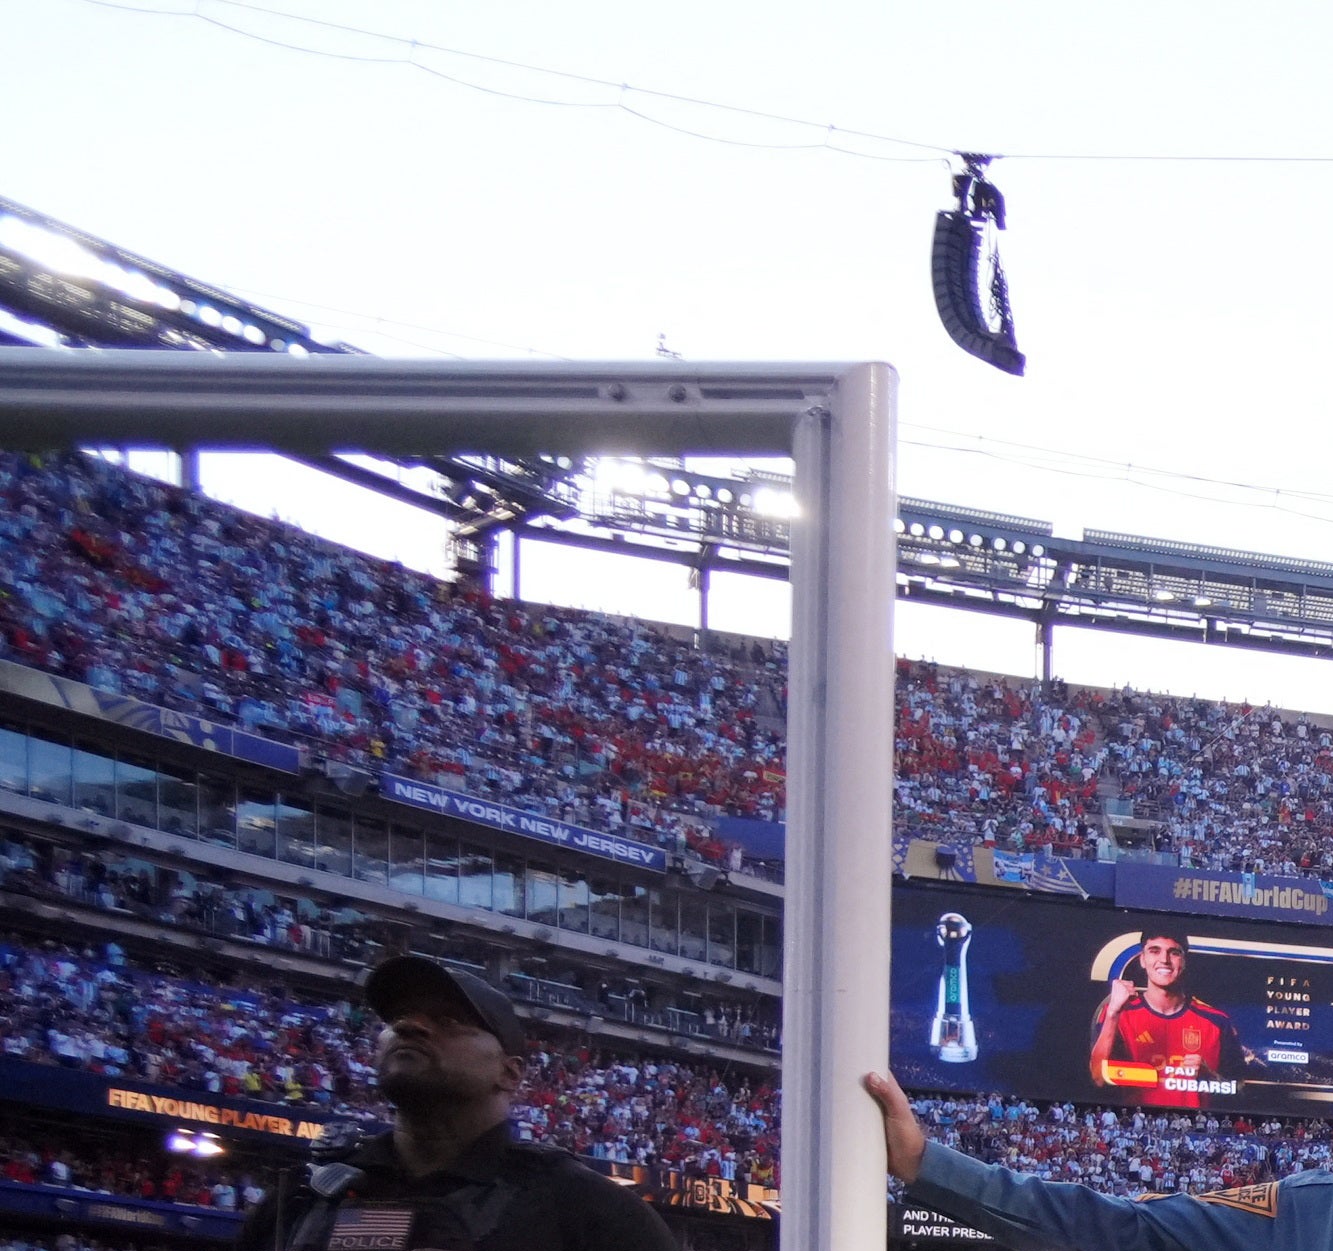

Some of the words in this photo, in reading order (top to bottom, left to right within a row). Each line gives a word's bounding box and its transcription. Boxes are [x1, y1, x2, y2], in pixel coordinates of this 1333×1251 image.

[394, 782, 449, 808] NEW
[453, 798, 516, 828] YORK
[520, 816, 570, 841] NEW
[574, 833, 655, 864] JERSEY
[1267, 976, 1310, 987] FIFA
[1266, 990, 1310, 1002] YOUNG
[1266, 1005, 1310, 1017] PLAYER
[1266, 1020, 1310, 1031] AWARD
[1270, 1052, 1306, 1062] aramco
[108, 1088, 150, 1111] FIFA
[150, 1094, 221, 1124] YOUNG
[221, 1108, 293, 1133] PLAYER
[903, 1209, 930, 1222] AND
[903, 1224, 950, 1237] PLAYER
[329, 1236, 405, 1248] POLICE
